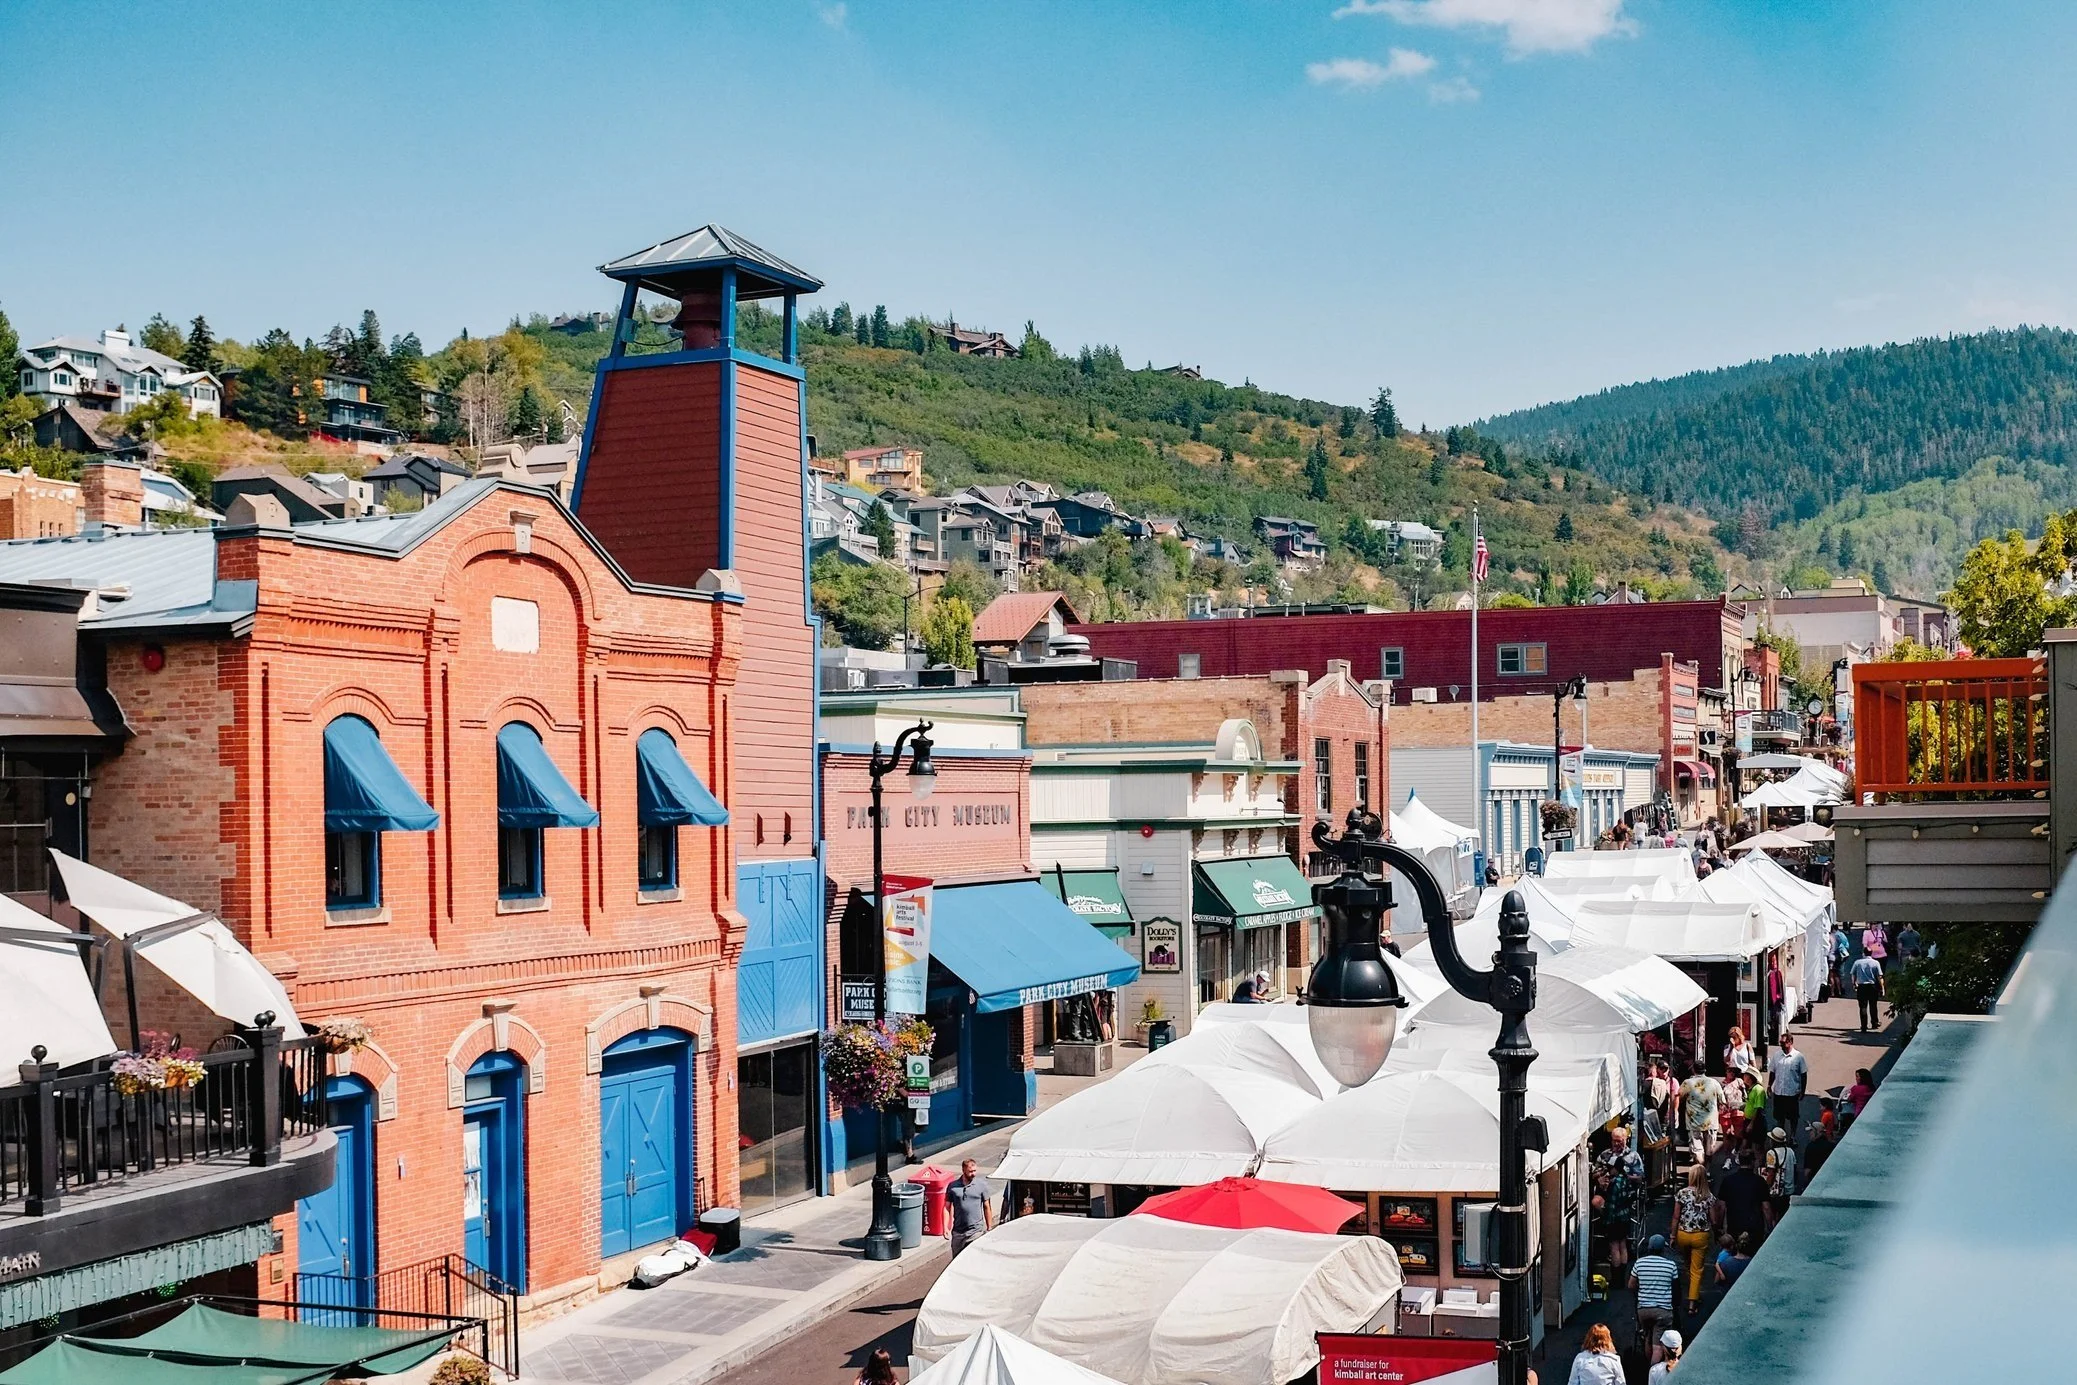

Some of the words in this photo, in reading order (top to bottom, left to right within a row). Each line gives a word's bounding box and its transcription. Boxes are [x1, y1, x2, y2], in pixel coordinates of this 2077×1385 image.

[847, 806, 890, 829] PAK
[905, 805, 940, 827] CITY
[953, 804, 1011, 826] MUSEUM
[845, 987, 870, 998] PARK
[1020, 985, 1045, 1005] PARK
[1047, 981, 1069, 1000] CITY
[1071, 974, 1108, 995] MUSEUM
[910, 1078, 916, 1086] 3
[1341, 1358, 1377, 1369] fundraiser
[1379, 1359, 1389, 1369] for
[1334, 1369, 1364, 1379] kimball
[1365, 1371, 1376, 1380] art
[1378, 1372, 1404, 1381] center
